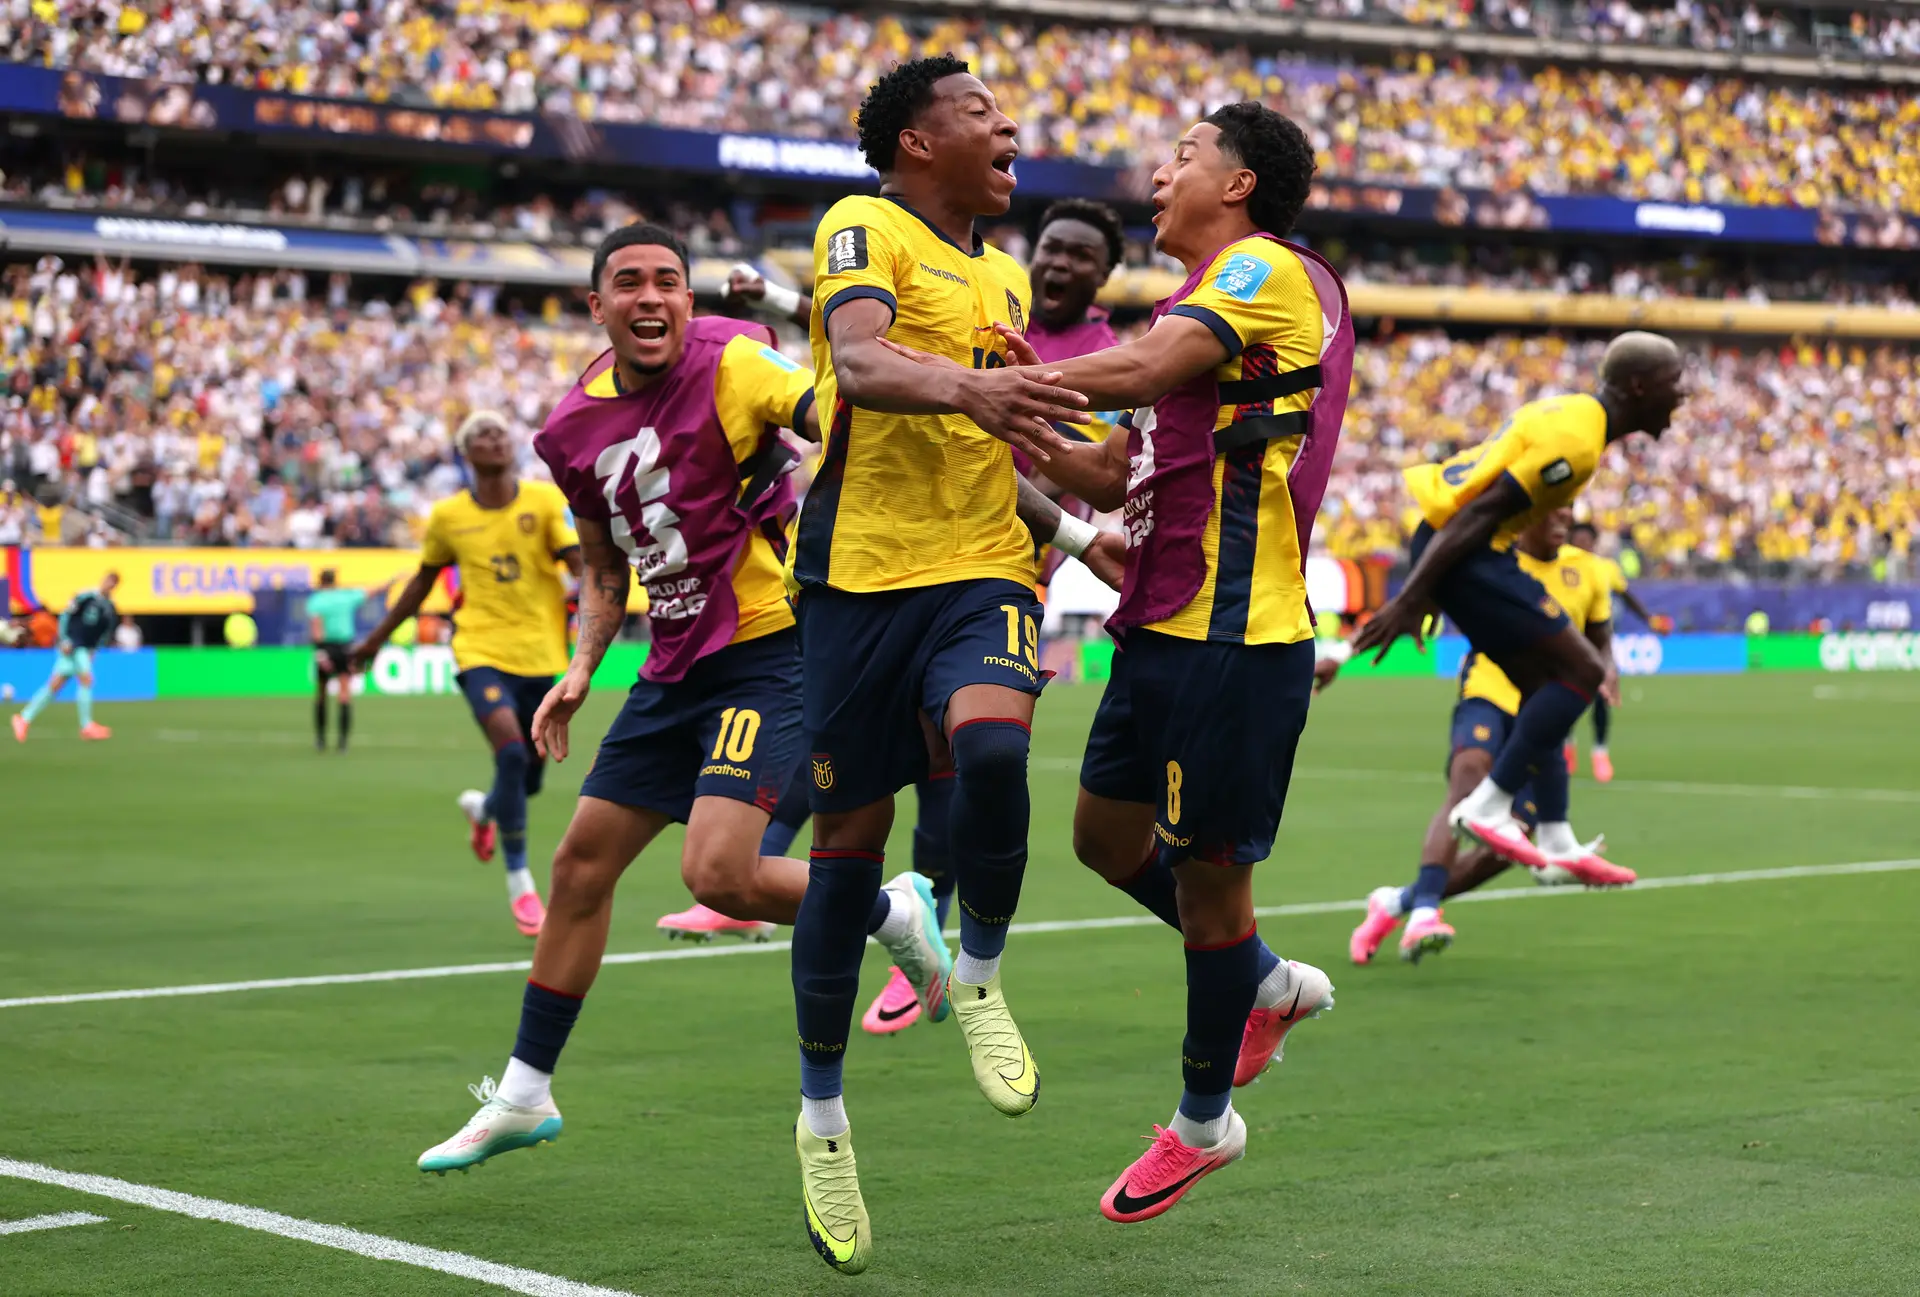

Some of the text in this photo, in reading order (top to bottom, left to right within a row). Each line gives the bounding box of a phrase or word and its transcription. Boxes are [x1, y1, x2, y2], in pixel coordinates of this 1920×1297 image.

[1123, 510, 1155, 550] 026
[677, 577, 701, 595] CUP
[1000, 605, 1039, 671] 19
[983, 656, 1037, 685] maratho
[711, 707, 761, 762] 10
[1166, 760, 1183, 825] 8
